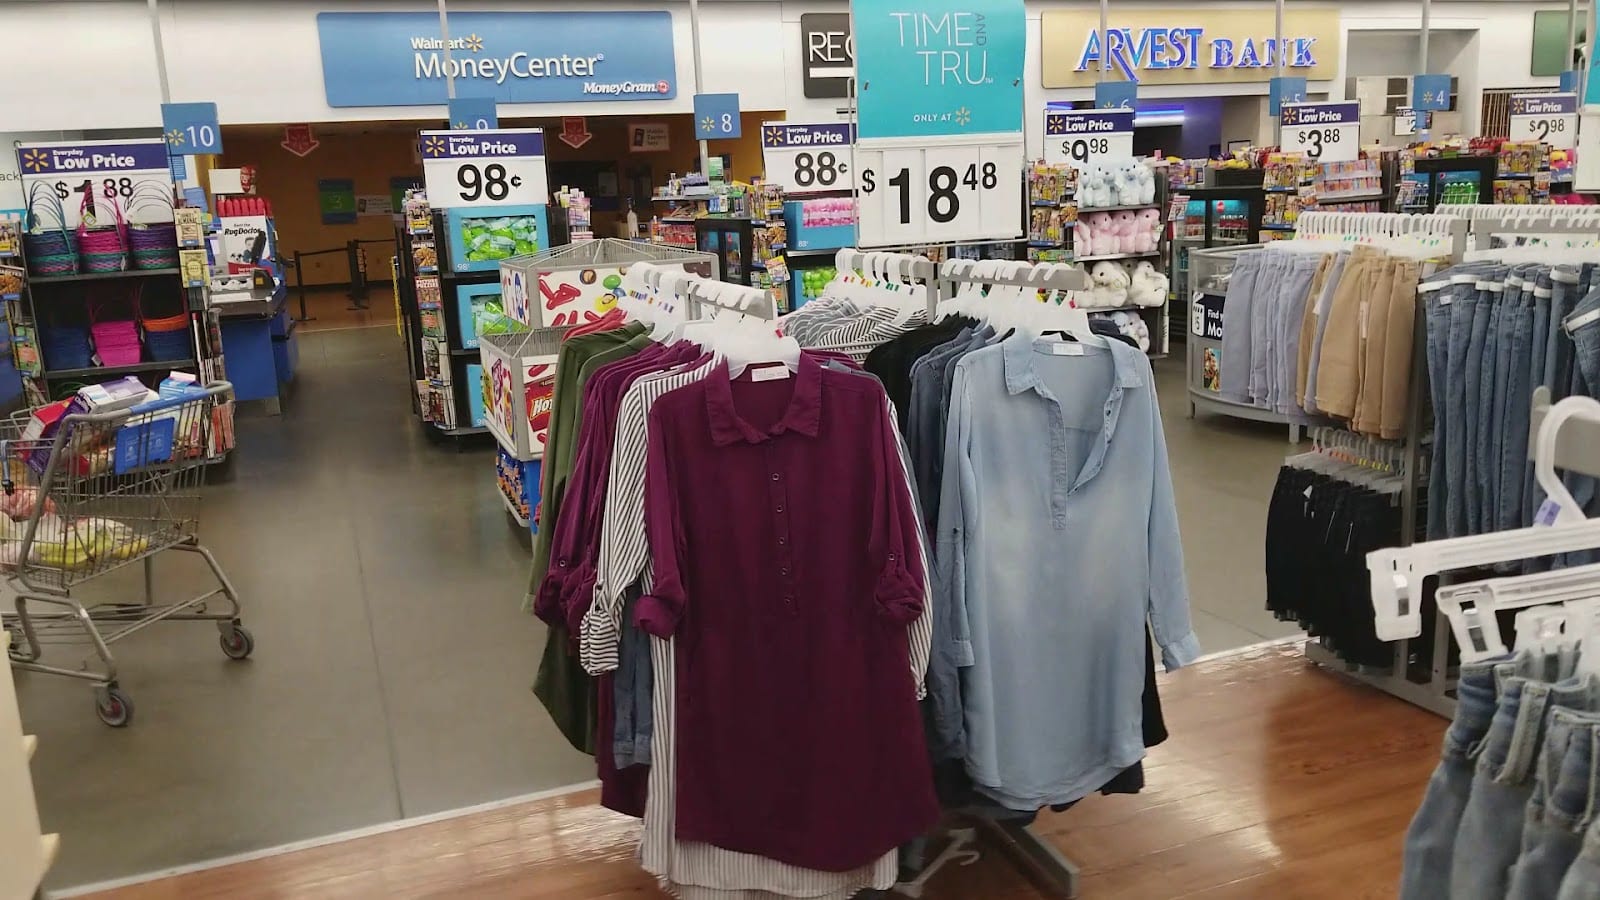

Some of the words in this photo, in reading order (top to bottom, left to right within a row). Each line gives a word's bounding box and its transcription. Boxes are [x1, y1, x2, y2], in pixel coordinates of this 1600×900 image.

[889, 12, 973, 47] TIME
[974, 13, 987, 47] AND
[411, 36, 464, 50] Walmart
[1073, 27, 1203, 82] ARVEST
[1208, 37, 1316, 69] BANK
[1435, 89, 1444, 105] 4
[1526, 103, 1541, 113] Low
[1542, 102, 1562, 112] Price
[720, 113, 733, 133] 8
[913, 114, 938, 122] ONLY
[941, 113, 952, 121] AT
[1299, 112, 1318, 123] Low
[1319, 110, 1342, 122] Price
[1065, 121, 1087, 132] Low
[1089, 119, 1114, 130] Price
[186, 125, 214, 148] 10
[787, 132, 811, 145] Low
[814, 131, 843, 144] Price
[53, 149, 83, 157] Everyday
[449, 142, 479, 155] Low
[481, 141, 517, 154] Price
[54, 157, 90, 170] Low
[92, 153, 136, 168] Price
[1208, 309, 1219, 319] Find
